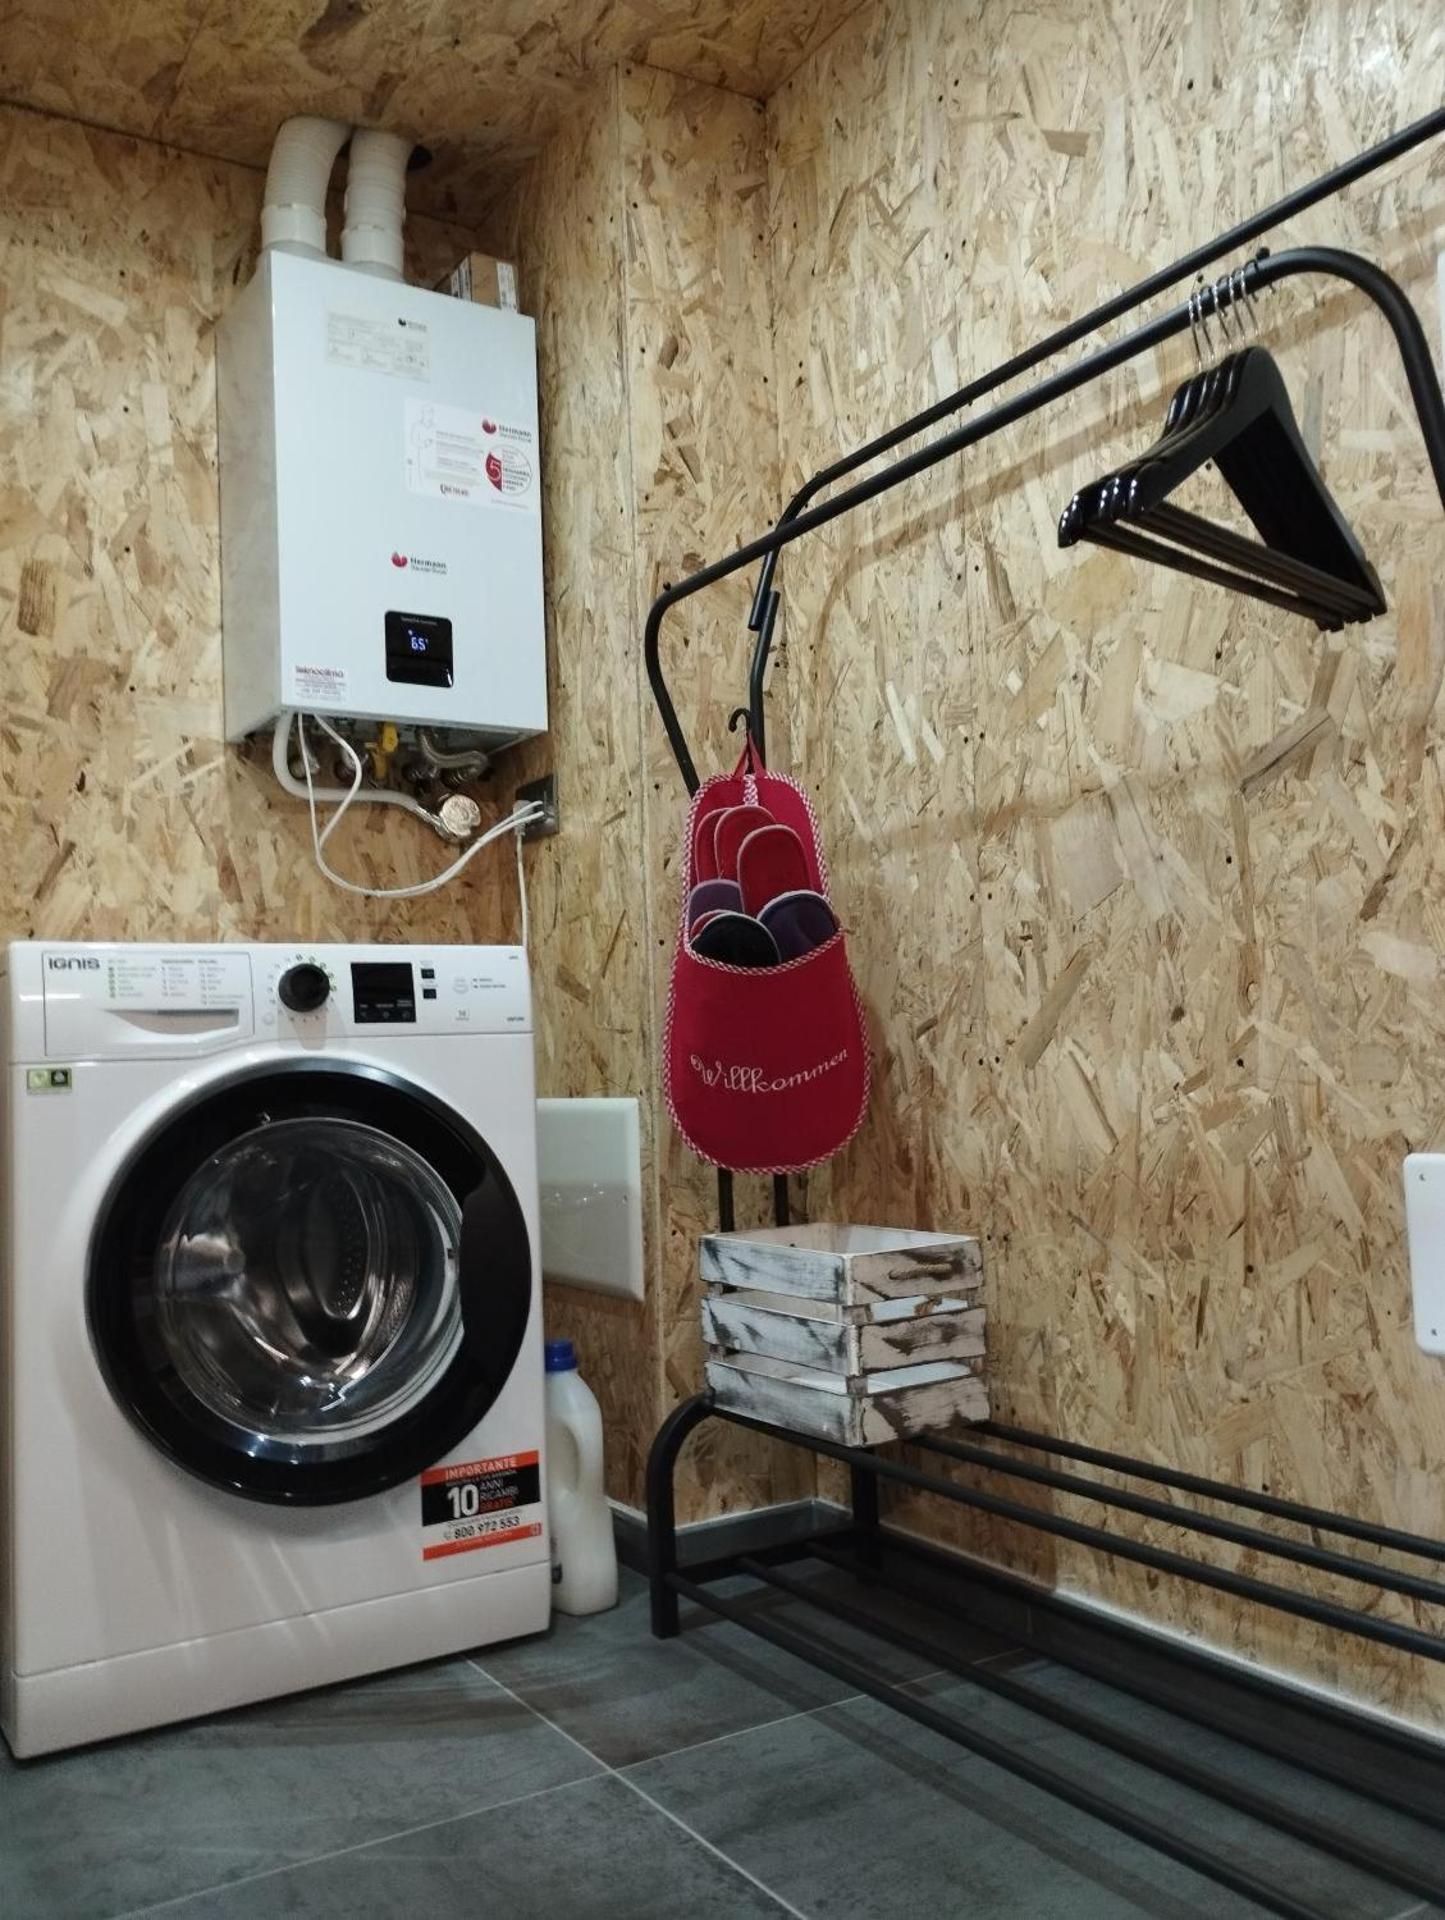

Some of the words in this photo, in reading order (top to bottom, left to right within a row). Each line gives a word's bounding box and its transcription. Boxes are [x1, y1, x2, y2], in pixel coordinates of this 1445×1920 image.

[489, 459, 501, 482] 5
[48, 957, 100, 970] IGNIS
[690, 1049, 848, 1093] Willkommen
[445, 1457, 517, 1480] IMPORTANTE
[481, 1479, 504, 1490] ANNI
[447, 1484, 479, 1518] 10
[454, 1525, 475, 1539] 800
